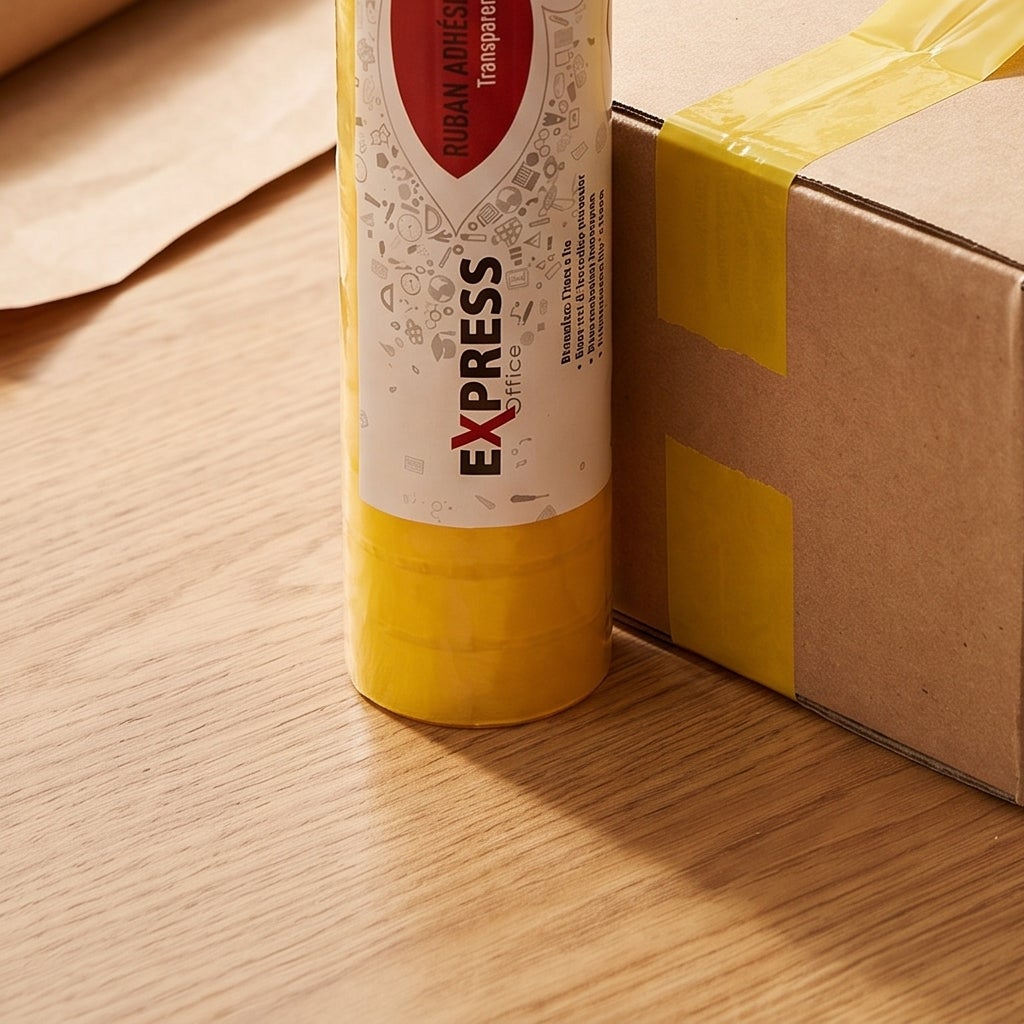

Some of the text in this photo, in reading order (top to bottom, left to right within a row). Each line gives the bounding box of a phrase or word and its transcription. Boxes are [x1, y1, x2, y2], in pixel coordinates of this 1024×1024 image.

[443, 83, 469, 158] RUBAN
[451, 256, 516, 476] EXPRESS
[505, 344, 522, 415] Office
